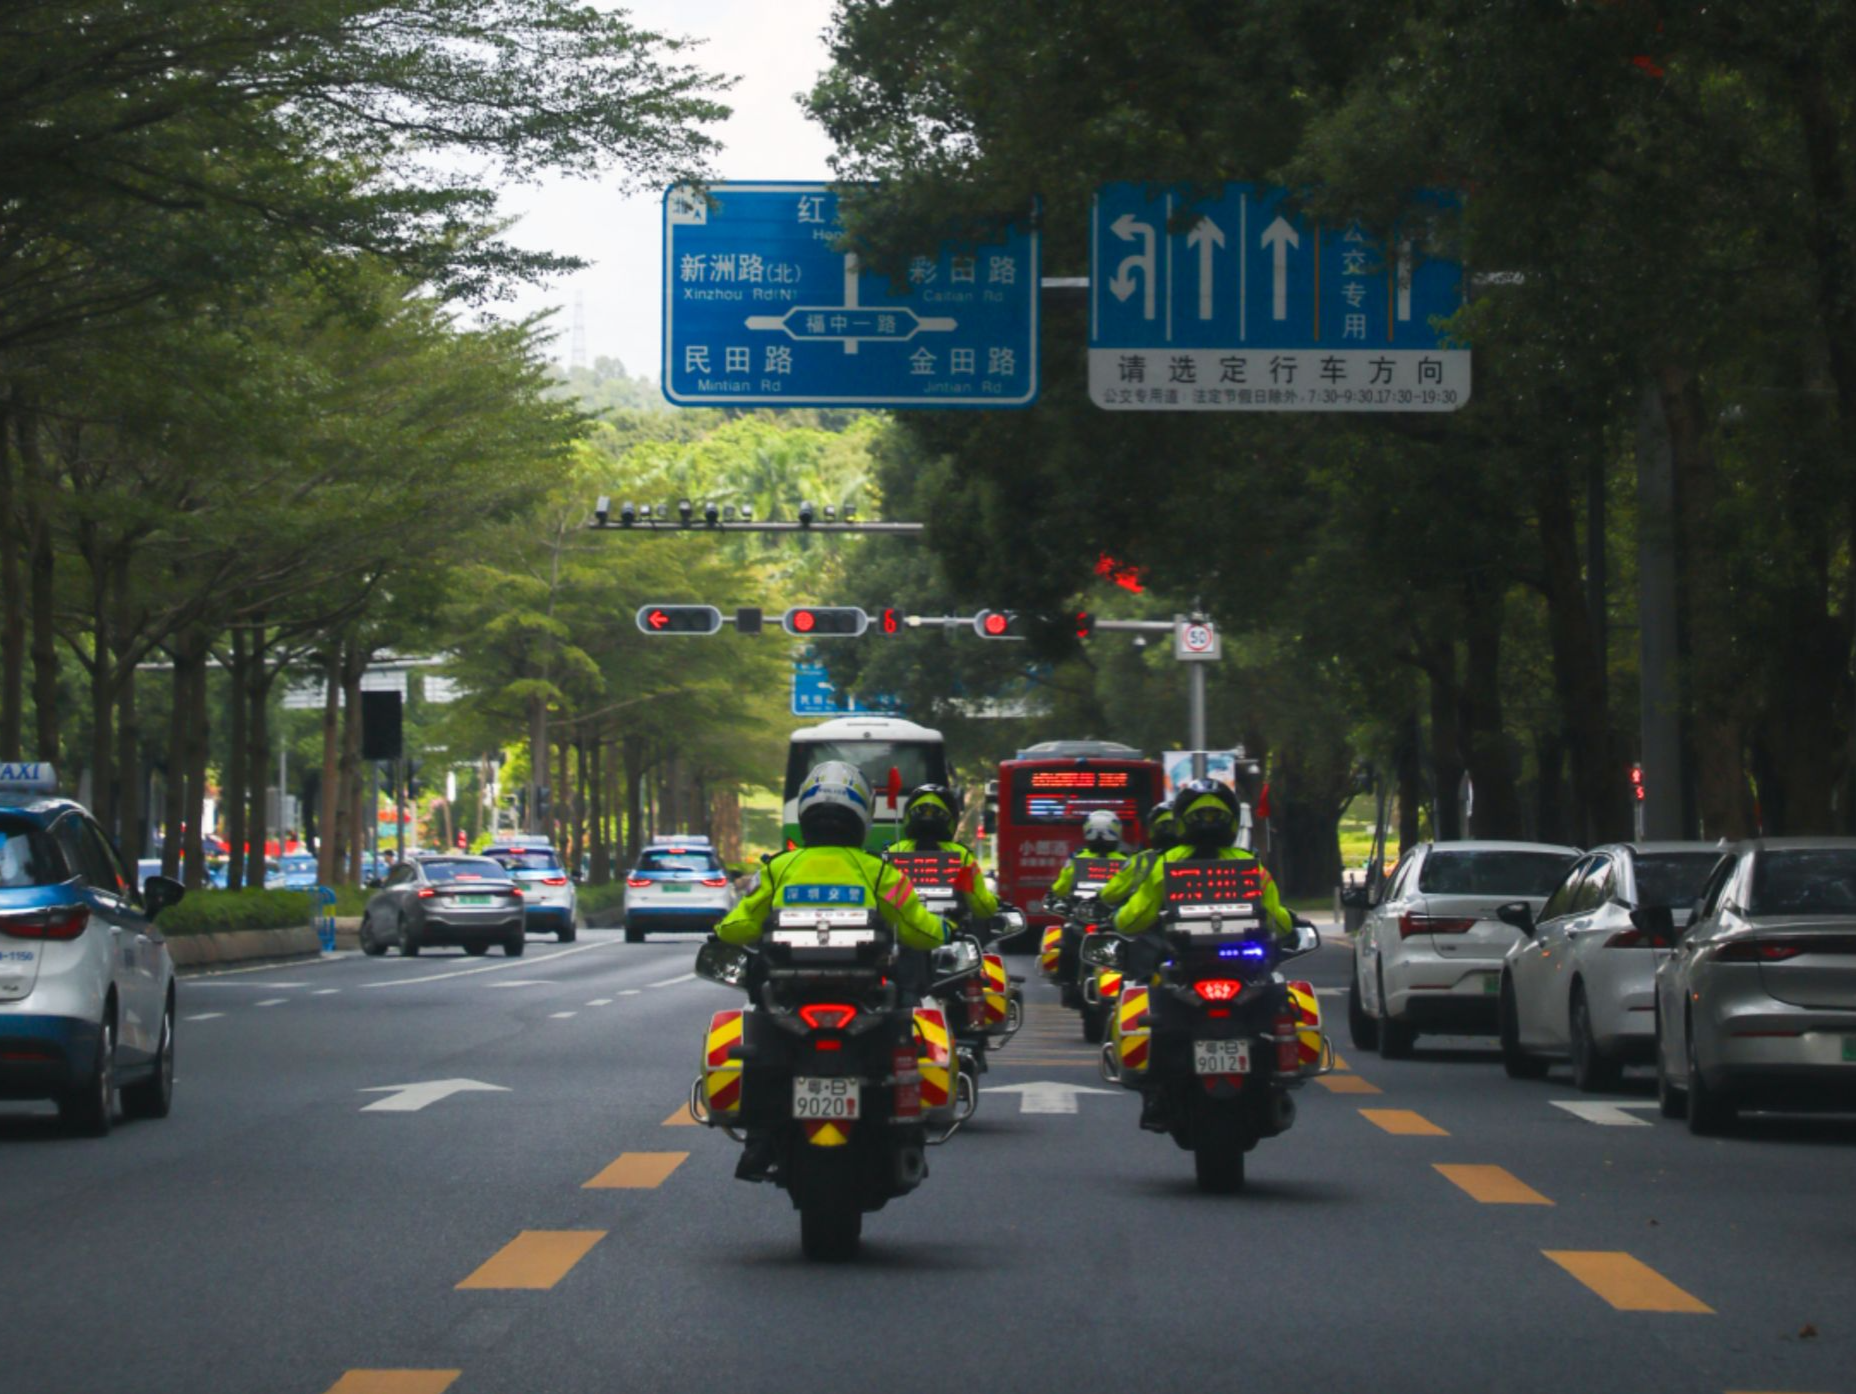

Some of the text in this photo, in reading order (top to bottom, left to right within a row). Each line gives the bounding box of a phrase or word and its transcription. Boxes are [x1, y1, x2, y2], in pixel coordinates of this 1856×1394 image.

[812, 229, 847, 241] Hon
[909, 255, 1017, 285] 彩田路
[683, 288, 743, 301] Xinzhou
[922, 289, 1003, 302] Caitian Rd
[805, 313, 897, 334] 福中一路
[684, 345, 793, 375] 民田路
[908, 347, 1016, 375] 金田路
[1117, 354, 1443, 385] 请选定行车方向
[698, 379, 782, 393] Mintian Rd
[923, 381, 1002, 395] Jintian Rd
[883, 608, 896, 634] 6
[1190, 630, 1207, 644] 50
[0, 763, 39, 780] AXI
[0, 951, 35, 961] -1150
